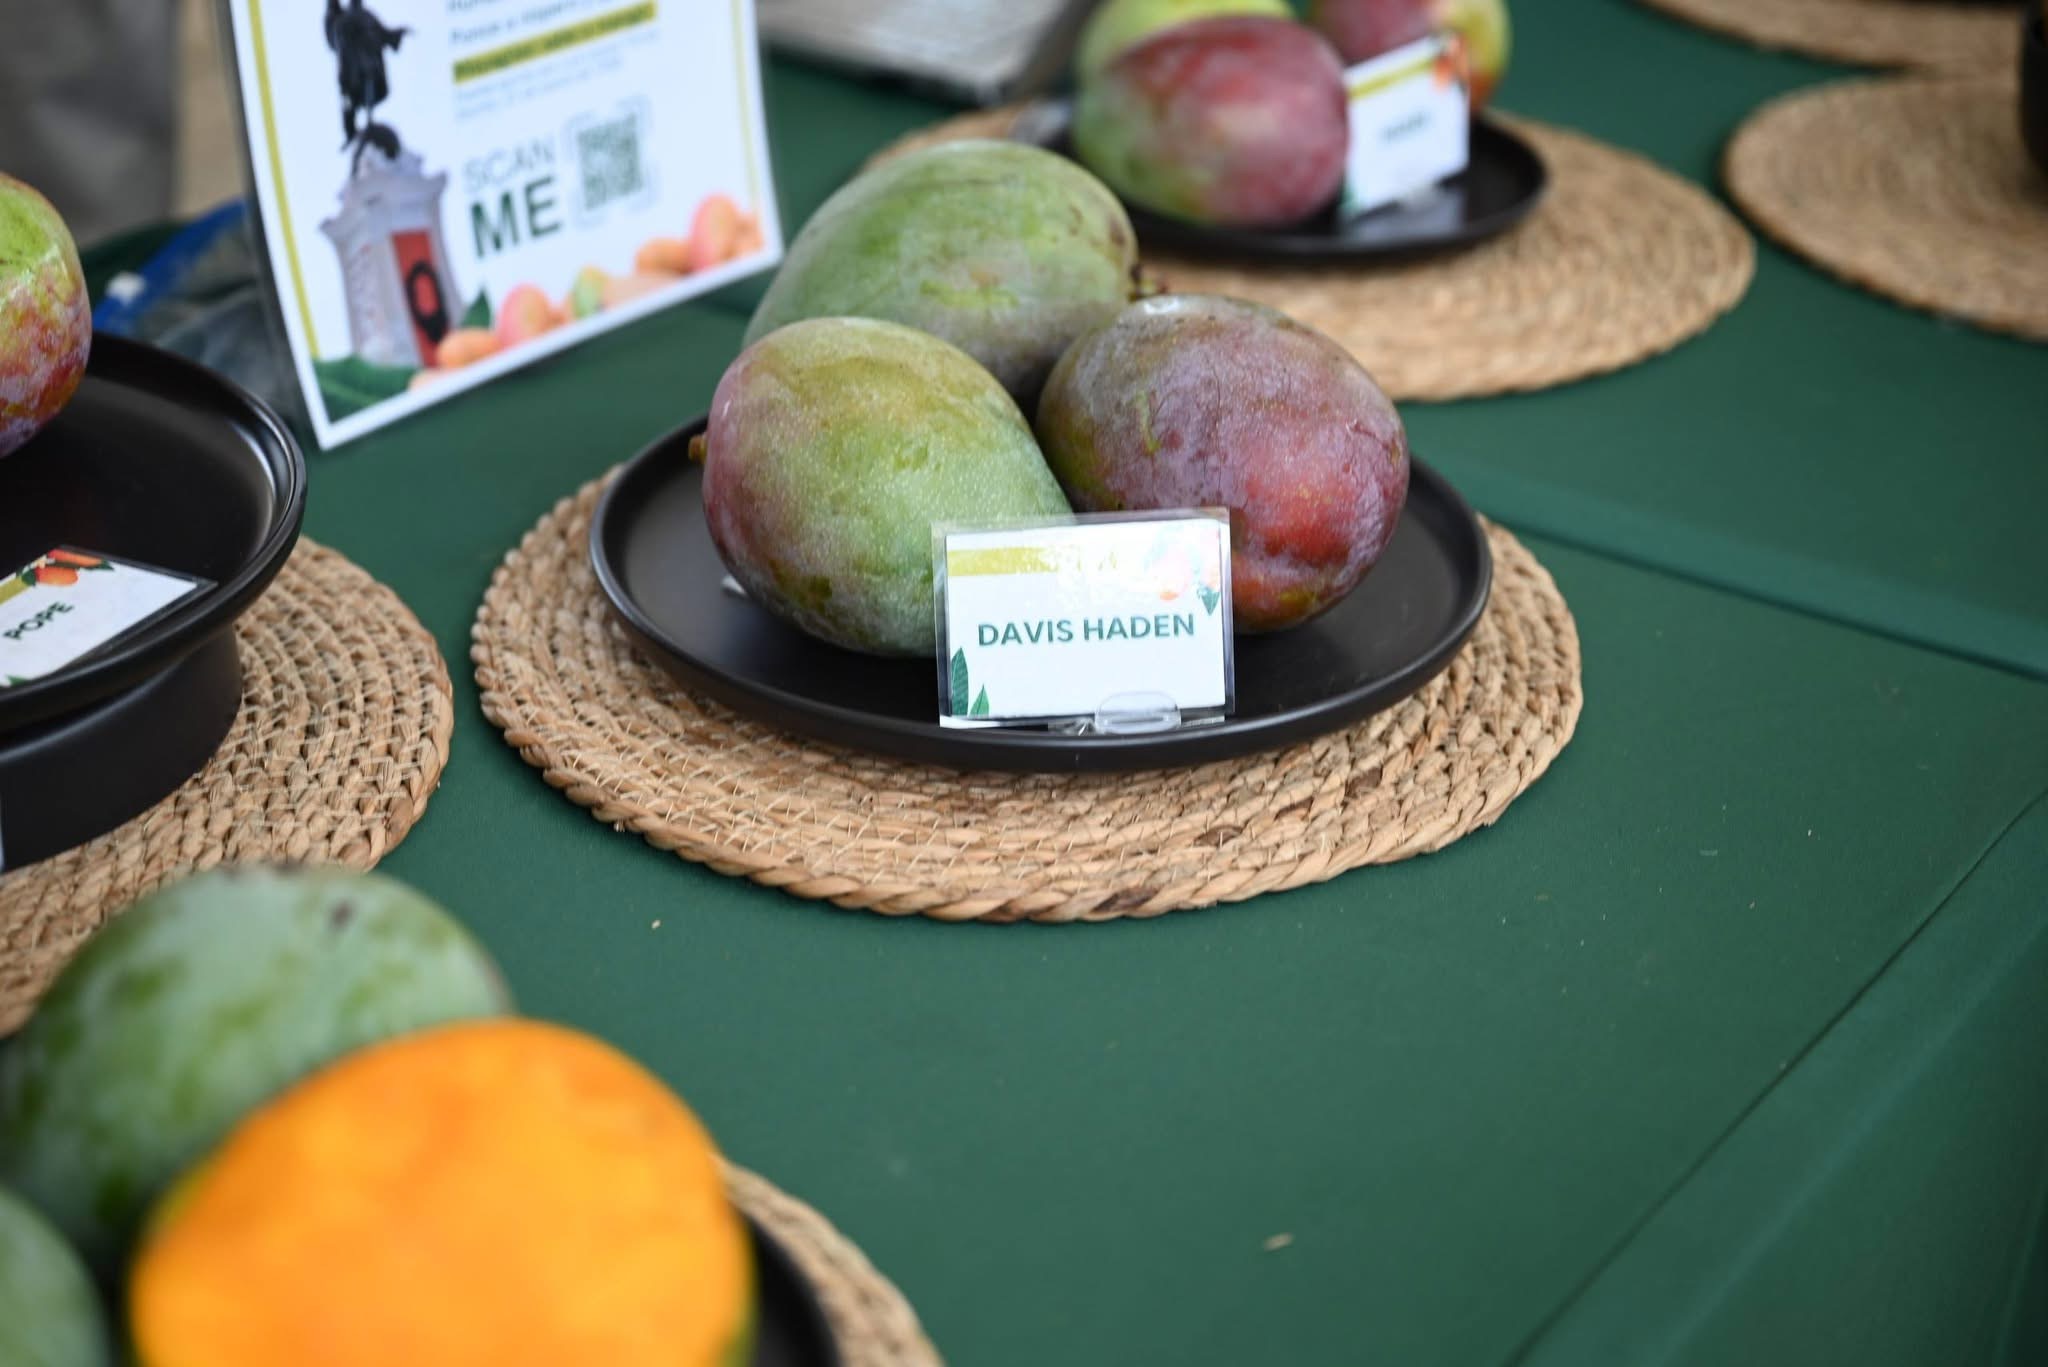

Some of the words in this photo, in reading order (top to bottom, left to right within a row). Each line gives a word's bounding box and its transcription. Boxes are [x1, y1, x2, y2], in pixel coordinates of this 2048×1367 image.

[465, 138, 555, 192] SCAN
[470, 175, 562, 259] ME
[3, 601, 75, 640] POPE
[978, 619, 1074, 647] DAVIS
[1083, 613, 1195, 641] HADEN
